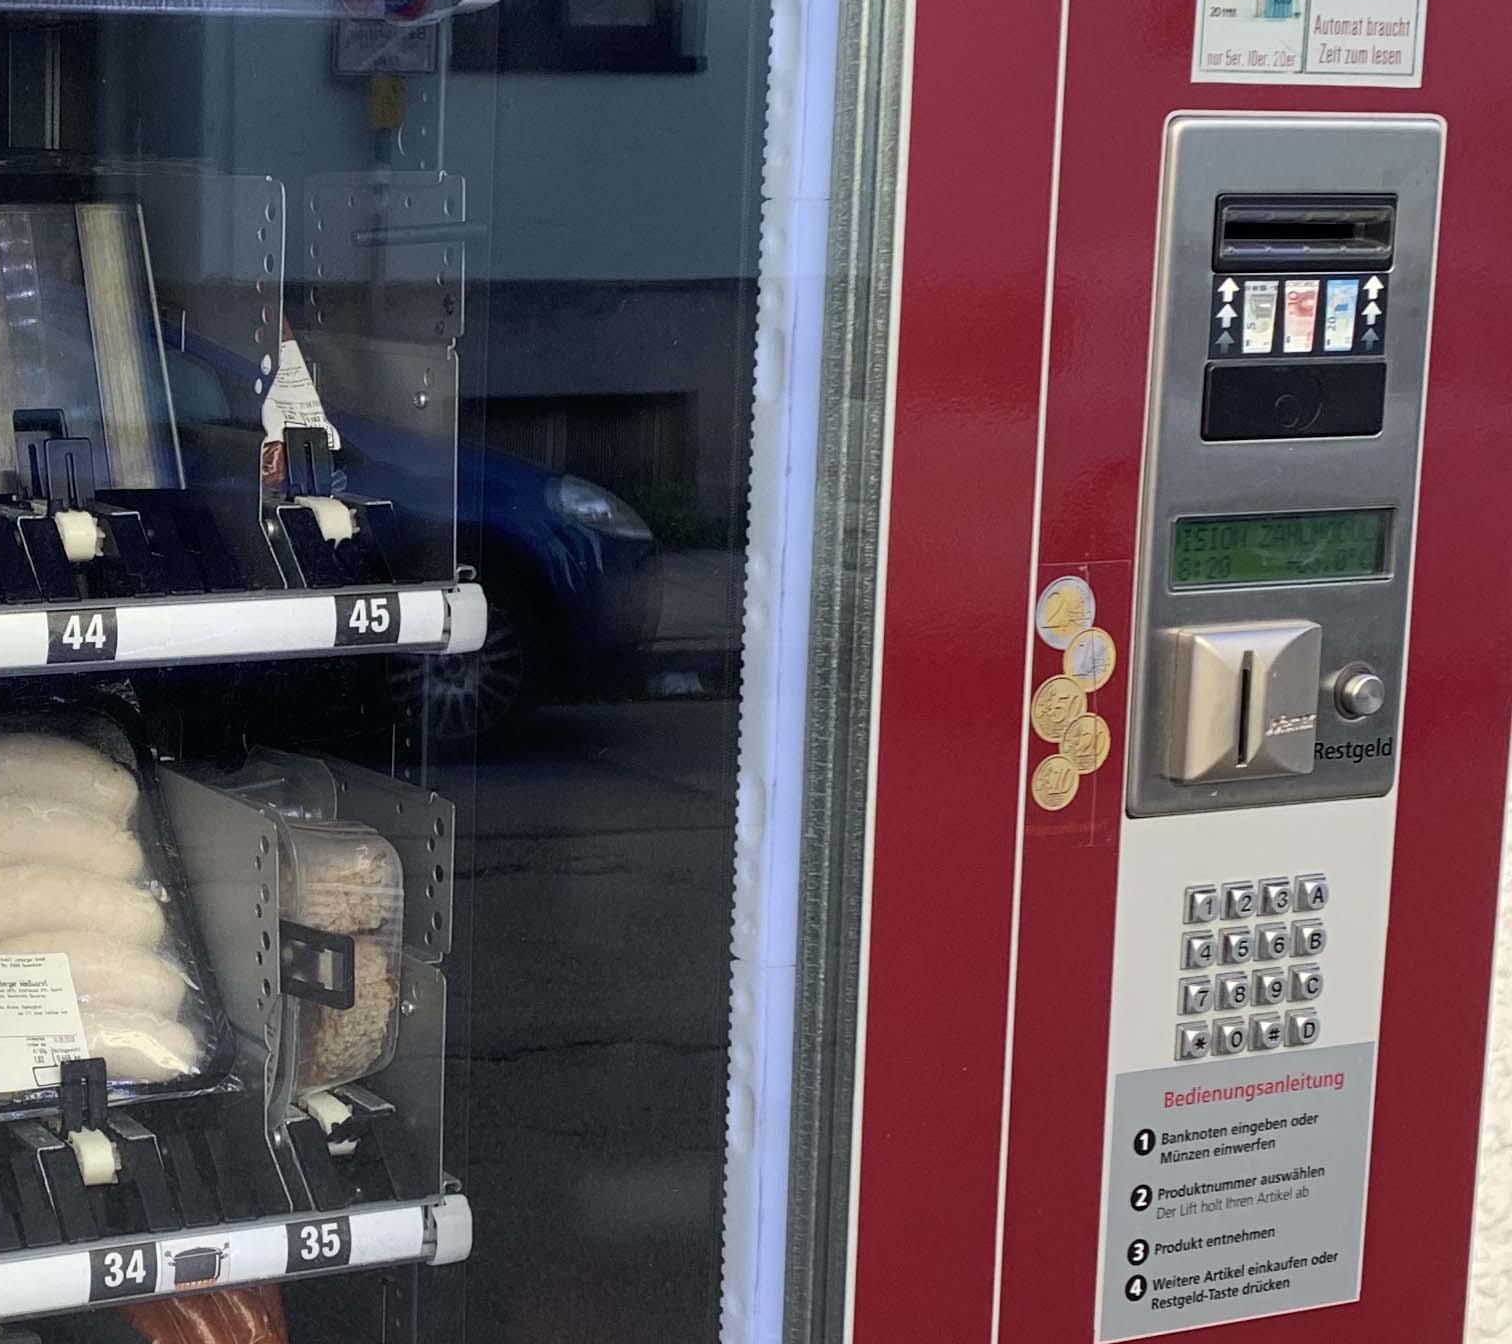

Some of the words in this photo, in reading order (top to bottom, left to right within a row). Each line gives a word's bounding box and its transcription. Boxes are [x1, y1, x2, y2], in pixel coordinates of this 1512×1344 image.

[1313, 14, 1364, 38] Automat
[1365, 15, 1412, 39] braucht
[1319, 42, 1342, 66] Zeit
[1345, 47, 1369, 66] zum
[1372, 43, 1403, 66] lesen
[63, 614, 106, 649] 44
[349, 598, 389, 633] 45
[1314, 737, 1393, 764] Restgeld
[1204, 899, 1214, 916] 1
[1240, 895, 1252, 913] 2
[1276, 891, 1288, 908] 3
[1311, 887, 1325, 905] A
[1199, 944, 1212, 962] 4
[1237, 940, 1249, 958] 5
[1274, 936, 1285, 954] 6
[1309, 932, 1322, 950] B
[1197, 989, 1209, 1007] 7
[1234, 986, 1246, 1003] 8
[1271, 981, 1283, 999] 9
[1306, 977, 1319, 995] C
[1231, 1030, 1243, 1048] 0
[1303, 1021, 1316, 1039] D
[1164, 1072, 1345, 1109] Bedienungsanleitung
[1139, 1133, 1149, 1151] 1
[1161, 1127, 1228, 1146] Banknoten
[1231, 1117, 1288, 1138] eingeben
[1291, 1113, 1320, 1128] oder
[1160, 1147, 1211, 1165] Münzen
[1213, 1137, 1277, 1157] einwerfen
[1136, 1189, 1148, 1207] 2
[1158, 1176, 1257, 1201] Produktnummer
[1260, 1165, 1326, 1186] auswählen
[1156, 1207, 1176, 1220] Der
[1179, 1202, 1198, 1217] Lift
[1201, 1198, 1223, 1214] holt
[1225, 1195, 1254, 1210] Ihren
[1257, 1188, 1293, 1206] Artikel
[1295, 1186, 1310, 1199] ab
[301, 1223, 340, 1259] 35
[1133, 1243, 1145, 1260] 3
[1154, 1237, 1203, 1256] Produkt
[1206, 1227, 1276, 1248] entnehmen
[104, 1249, 146, 1287] 34
[1129, 1279, 1142, 1296] 4
[1152, 1273, 1201, 1291] Weitere
[1204, 1265, 1245, 1283] Artikel
[1248, 1256, 1309, 1276] einkaufen
[1311, 1251, 1339, 1266] oder
[1151, 1285, 1239, 1310] Restgeld-Taste
[1242, 1277, 1291, 1296] drücken
